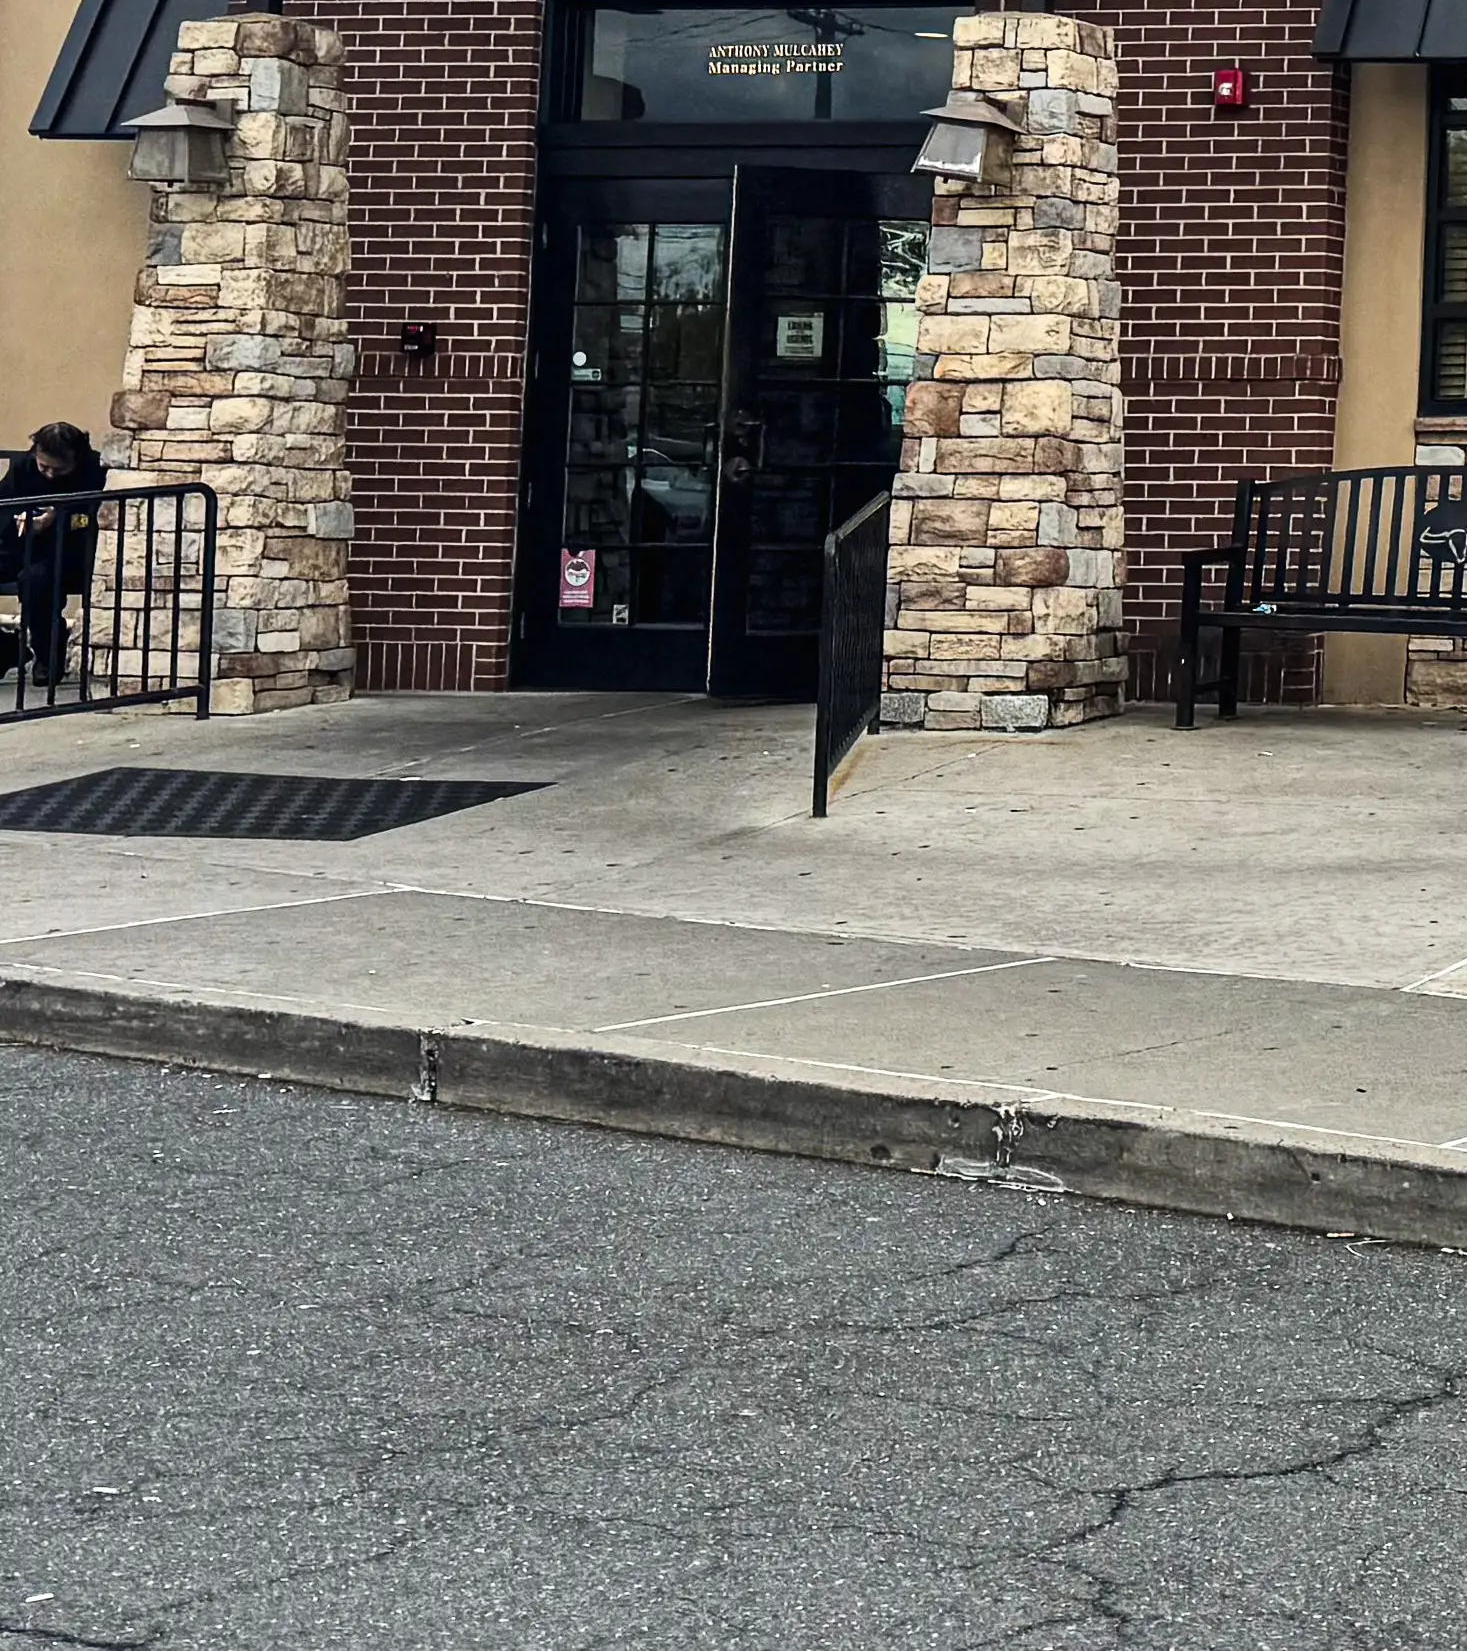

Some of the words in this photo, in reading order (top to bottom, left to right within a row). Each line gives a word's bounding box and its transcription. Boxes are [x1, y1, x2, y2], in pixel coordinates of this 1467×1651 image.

[709, 44, 770, 58] ANTHONY
[774, 43, 844, 57] MULCAHEY
[708, 59, 781, 75] Managing
[786, 59, 844, 73] Partner
